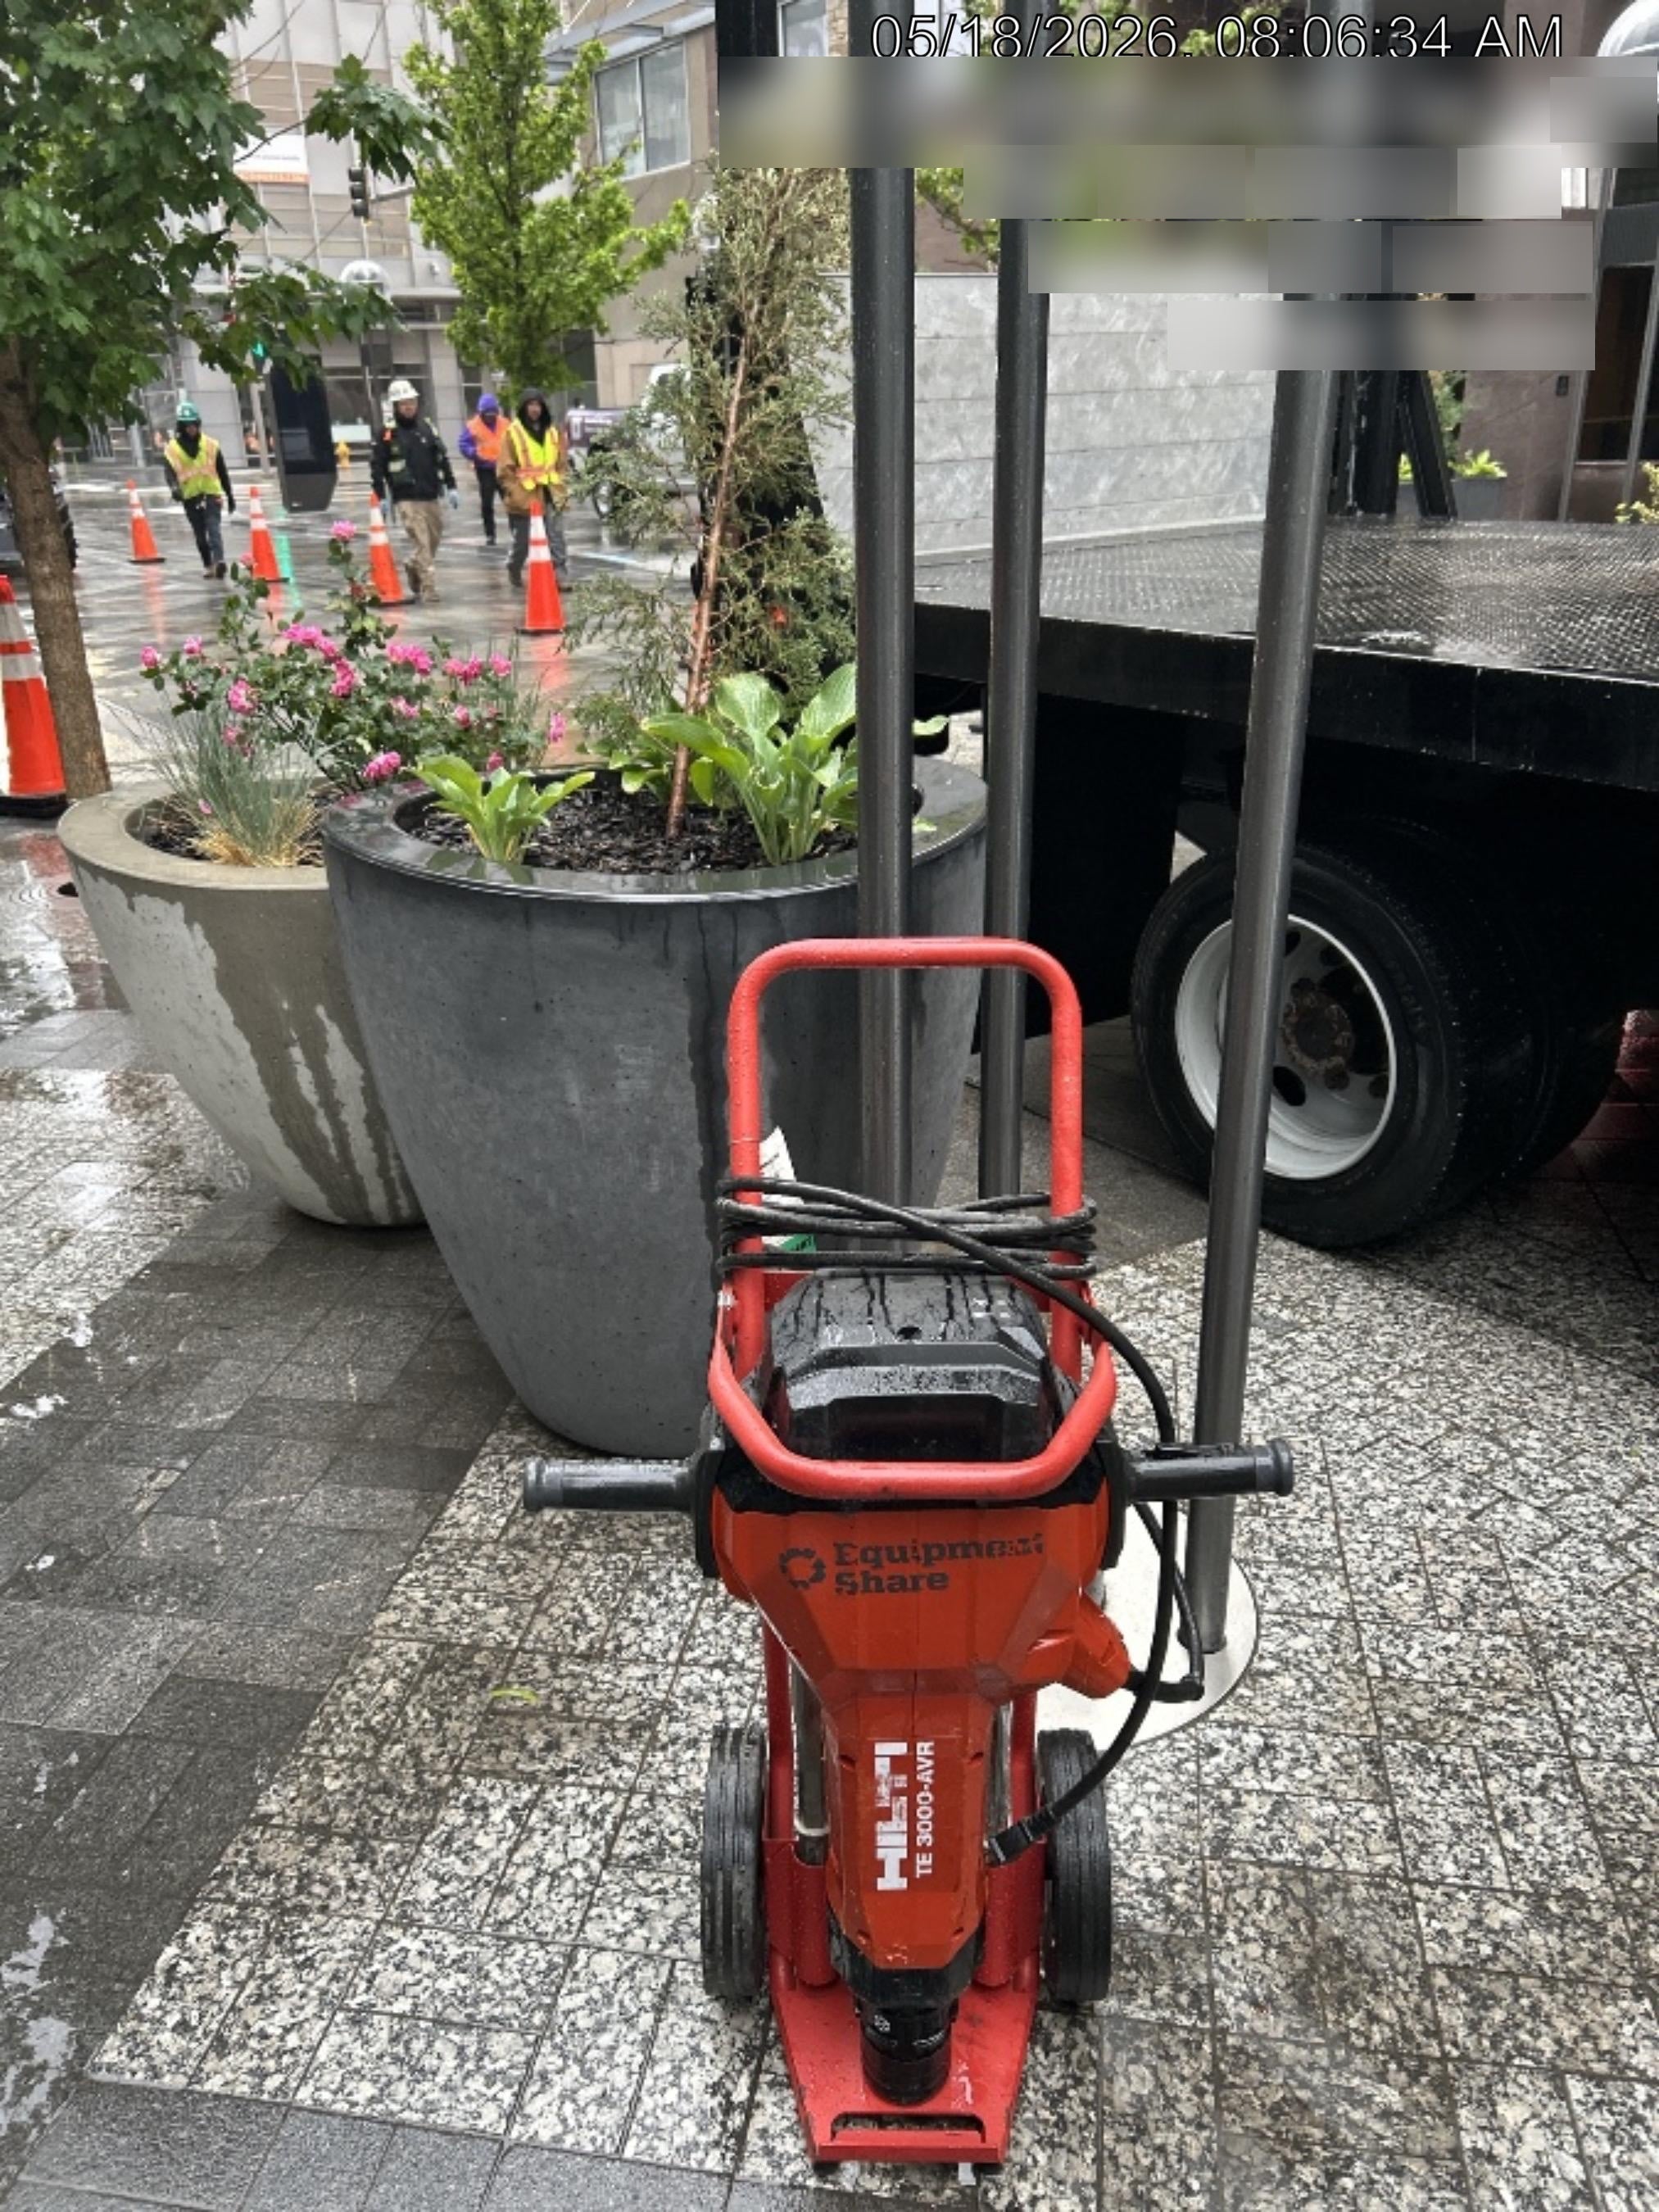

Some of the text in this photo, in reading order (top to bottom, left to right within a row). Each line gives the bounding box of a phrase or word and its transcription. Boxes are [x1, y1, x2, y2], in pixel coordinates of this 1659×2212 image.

[834, 1570, 950, 1595] Share
[874, 1741, 908, 1891] HILTI
[915, 1741, 935, 1879] TE 3000-AVR
